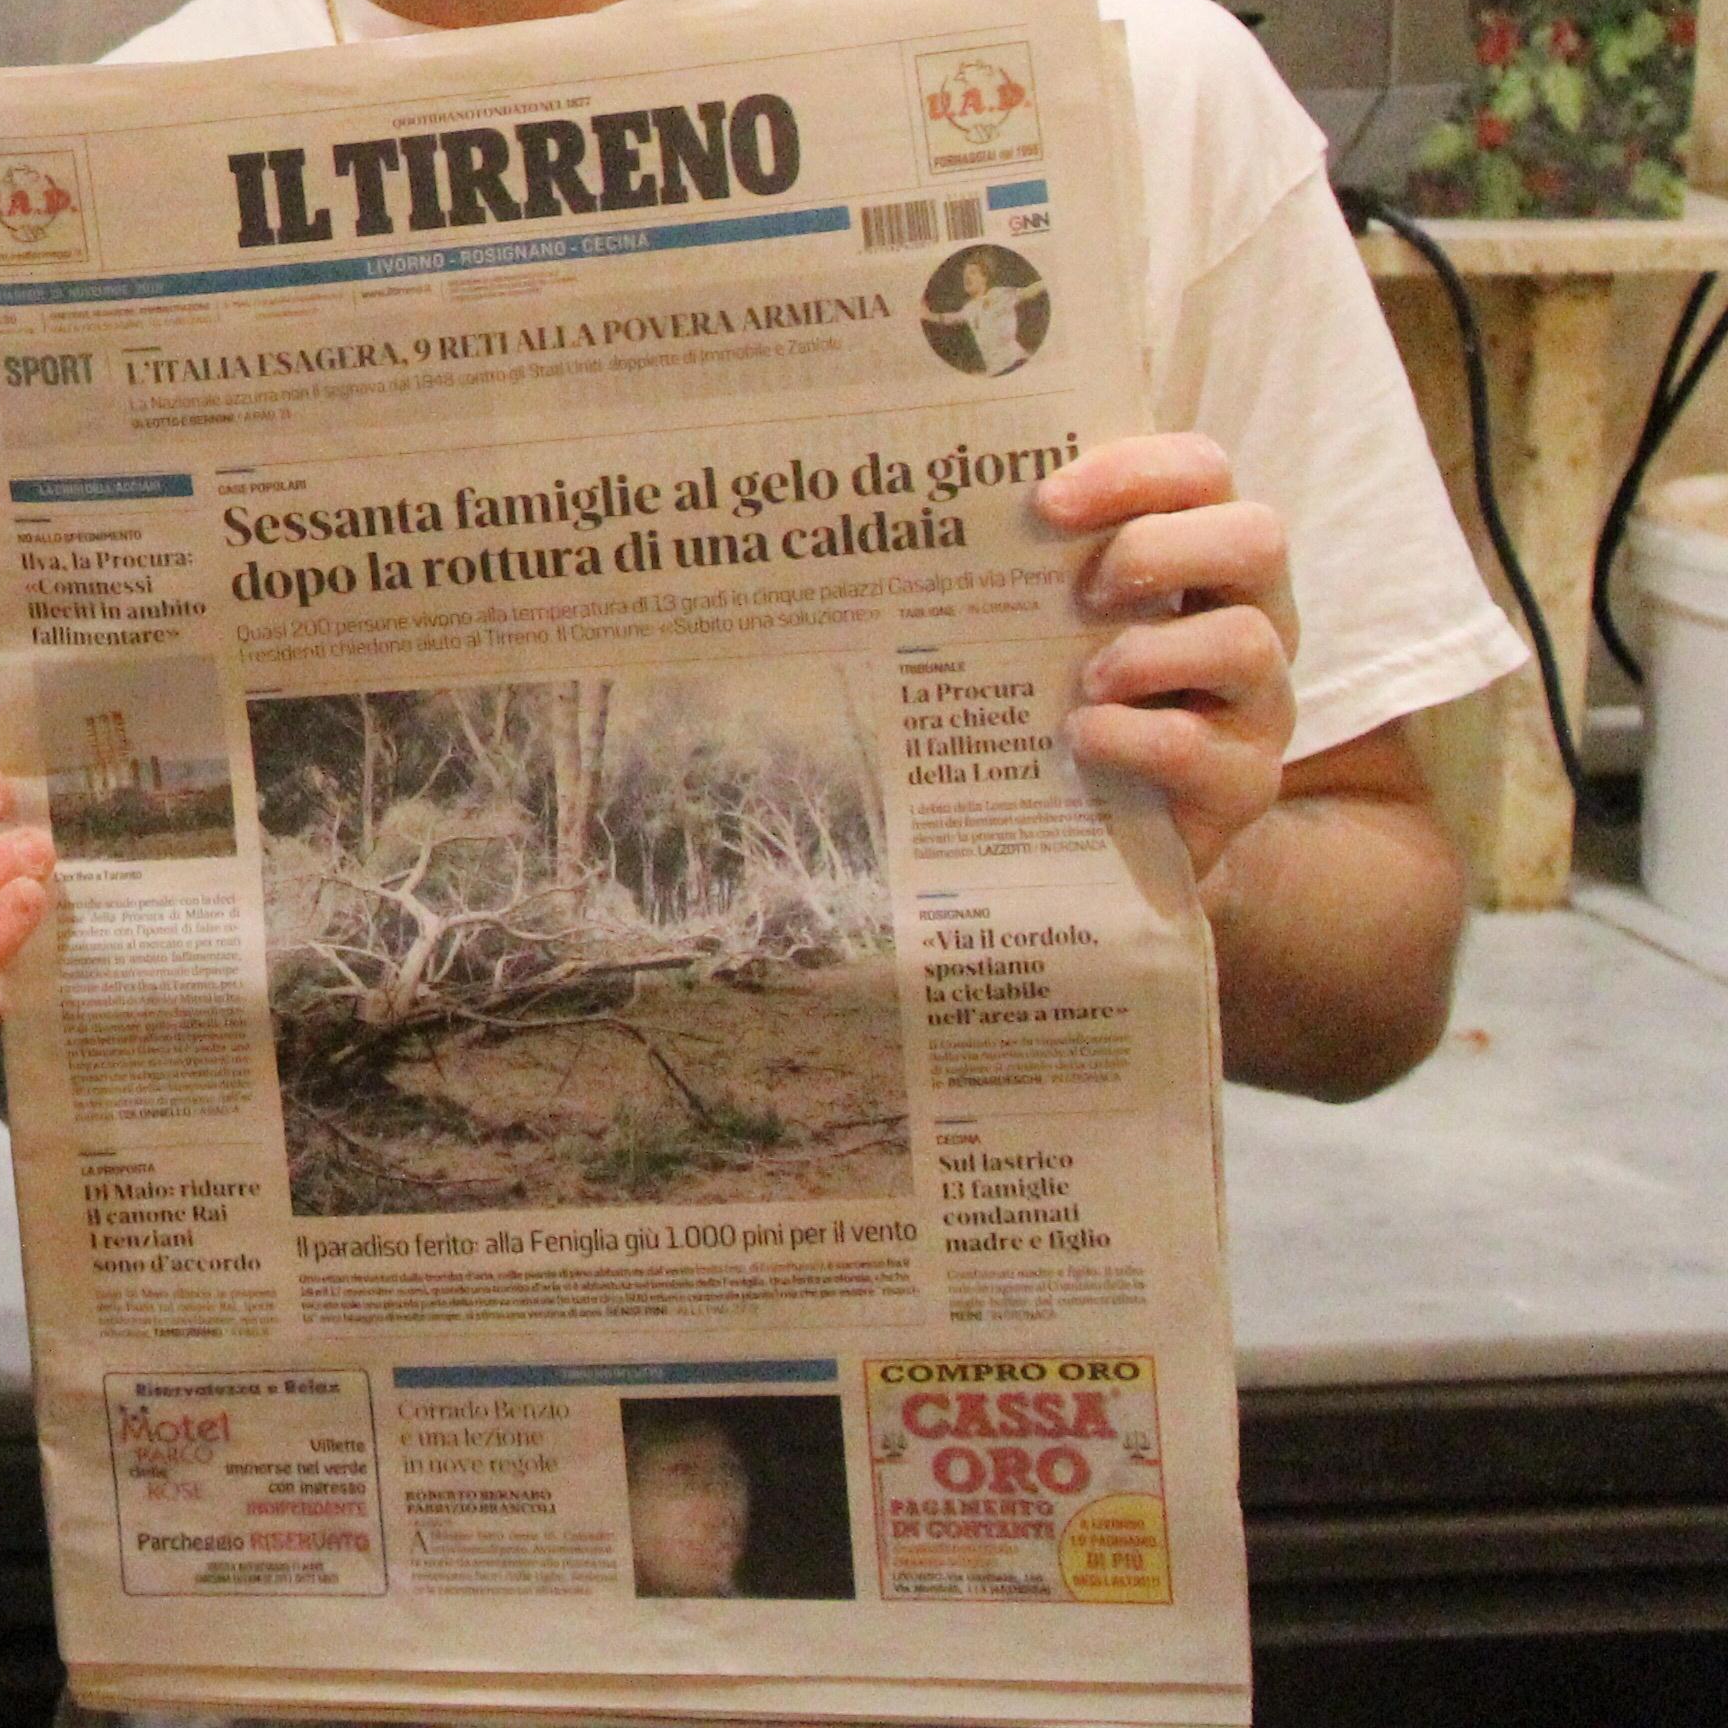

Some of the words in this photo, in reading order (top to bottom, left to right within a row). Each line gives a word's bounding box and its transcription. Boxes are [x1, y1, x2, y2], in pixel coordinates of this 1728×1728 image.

[228, 148, 332, 248] IL
[333, 94, 799, 237] TIRRENO
[367, 253, 449, 275] LIVORNO
[414, 340, 430, 360] 9
[439, 332, 507, 360] RETI
[521, 324, 596, 351] ALLA
[604, 310, 734, 344] POVERA
[747, 294, 890, 330] ARMENIA
[4, 353, 92, 387] SPORT
[224, 499, 443, 545] Sessanta
[455, 475, 660, 529] famiglie
[675, 467, 717, 511] al
[731, 460, 838, 517] gelo
[852, 452, 914, 496] da
[72, 552, 91, 570] la
[232, 562, 356, 607] dopo
[368, 552, 412, 591] la
[423, 547, 599, 587] rottura
[614, 530, 661, 572] di
[674, 533, 769, 568] una
[782, 507, 966, 559] caldaia
[127, 600, 206, 619] ambito
[291, 617, 332, 638] 200
[335, 617, 408, 644] persone
[412, 612, 472, 629] vivono
[476, 605, 508, 624] alla
[511, 601, 629, 628] temperatura
[631, 597, 648, 613] di
[681, 590, 728, 615] gradi
[753, 587, 816, 606] cinque
[956, 571, 974, 589] di
[978, 570, 1007, 588] via
[902, 686, 929, 704] La
[937, 683, 1034, 702] Procura
[903, 716, 943, 730] ora
[949, 706, 1029, 728] chiede
[927, 736, 1054, 756] fallimento
[908, 764, 966, 785] della
[973, 759, 1040, 782] Lonzi
[924, 958, 1044, 979] spostiamo
[926, 986, 945, 1003] la
[952, 982, 1050, 1002] ciclabile
[1035, 1010, 1047, 1021] a
[939, 1154, 975, 1172] Sul
[982, 1151, 1073, 1171] lastrico
[85, 1184, 108, 1201] Di
[180, 1180, 260, 1197] ridurre
[972, 1177, 1069, 1200] famiglie
[106, 1210, 185, 1226] canone
[193, 1205, 227, 1222] Rai
[943, 1204, 1078, 1225] condannati
[103, 1230, 193, 1249] renziani
[297, 1238, 308, 1257] Il
[313, 1235, 409, 1263] paradiso
[486, 1231, 524, 1254] alla
[530, 1228, 619, 1258] Feniglia
[743, 1223, 784, 1252] pini
[790, 1227, 826, 1251] per
[851, 1221, 917, 1242] vento
[946, 1232, 1022, 1252] madre
[1049, 1229, 1110, 1252] figlio
[93, 1260, 144, 1272] sono
[880, 1363, 1046, 1383] COMPRO
[1059, 1362, 1139, 1381] ORO
[397, 1400, 489, 1419] Corrado
[902, 1392, 1116, 1439] CASSA
[117, 1408, 230, 1447] Motel
[418, 1432, 458, 1446] una
[464, 1427, 543, 1446] lezione
[493, 1453, 558, 1478] regole
[932, 1445, 1090, 1495] ORO
